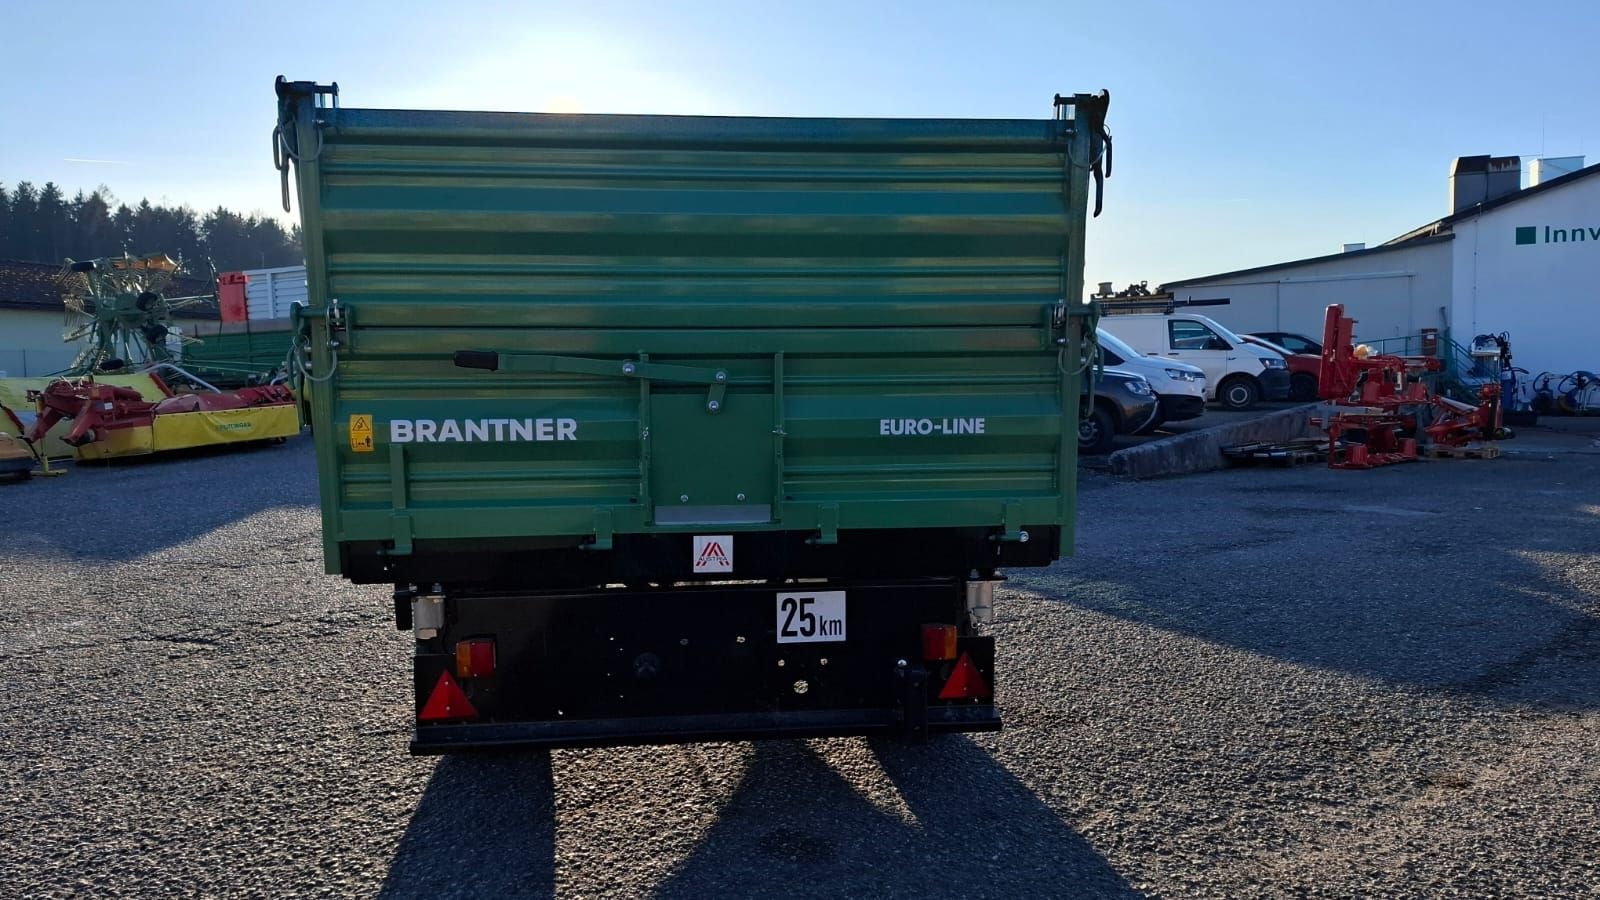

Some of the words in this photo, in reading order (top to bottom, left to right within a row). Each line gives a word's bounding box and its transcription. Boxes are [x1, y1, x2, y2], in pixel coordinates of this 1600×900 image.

[390, 418, 578, 443] BRANTNER
[880, 418, 985, 435] EURO-LINE
[781, 597, 816, 637] 25
[819, 615, 842, 636] km
